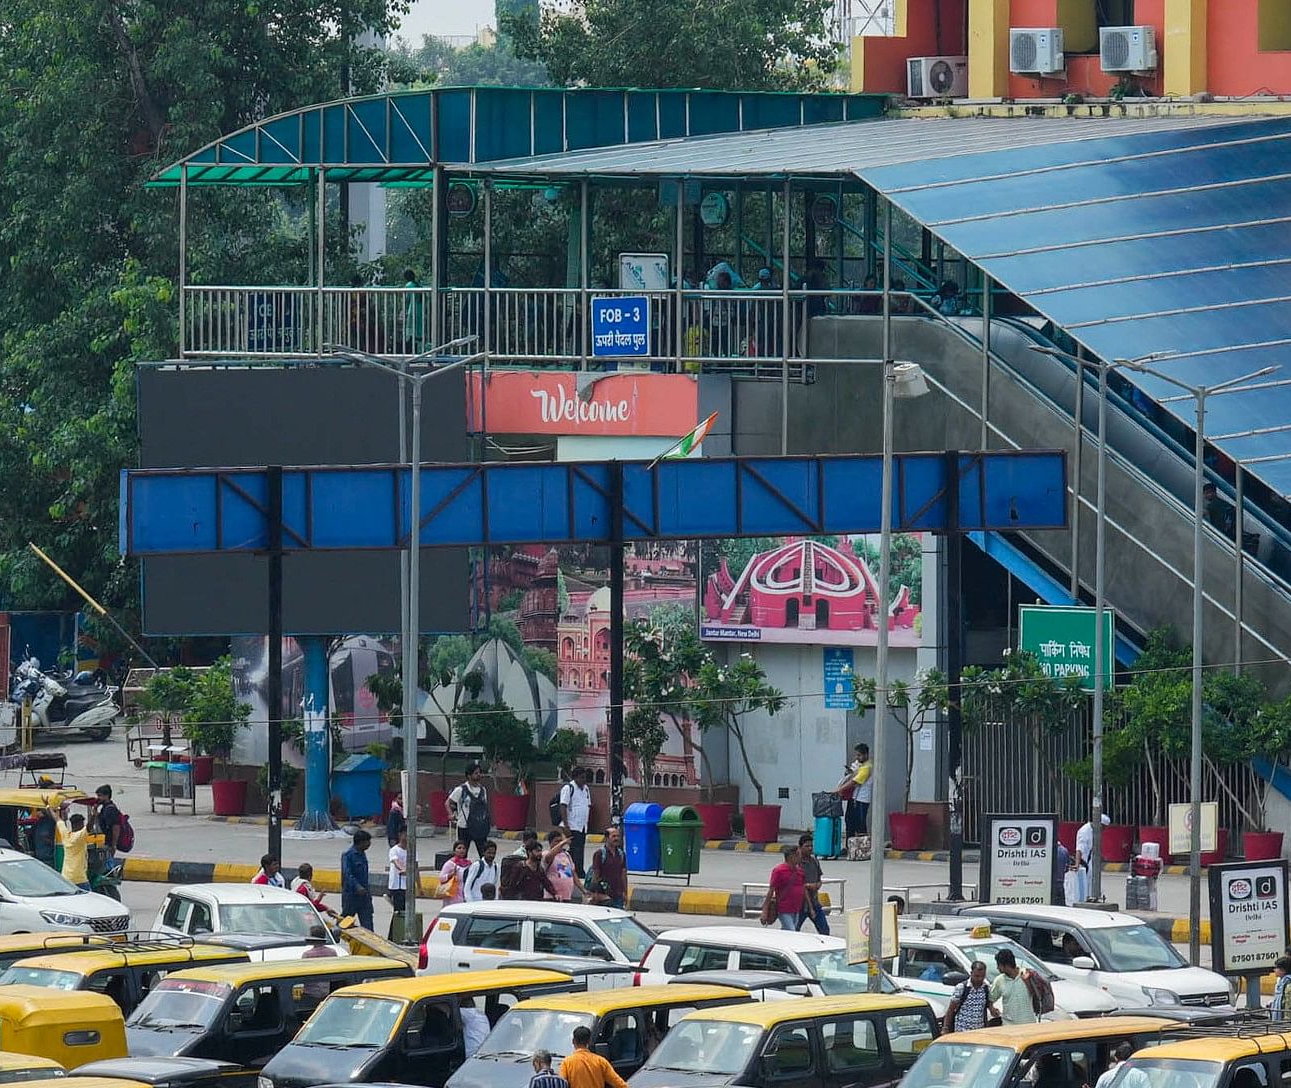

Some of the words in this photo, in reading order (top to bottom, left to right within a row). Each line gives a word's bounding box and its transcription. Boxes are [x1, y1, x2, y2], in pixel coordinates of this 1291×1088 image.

[600, 308, 622, 323] FOB
[633, 307, 640, 322] 3
[615, 329, 631, 346] पैदल
[632, 333, 646, 351] पुल
[531, 384, 631, 425] Welcome
[1069, 641, 1091, 658] निषेध
[1054, 663, 1089, 679] PARKING
[997, 849, 1027, 858] Drishti
[1030, 849, 1046, 858] IAS
[1228, 902, 1259, 913] Drishti
[1262, 901, 1278, 910] IAS
